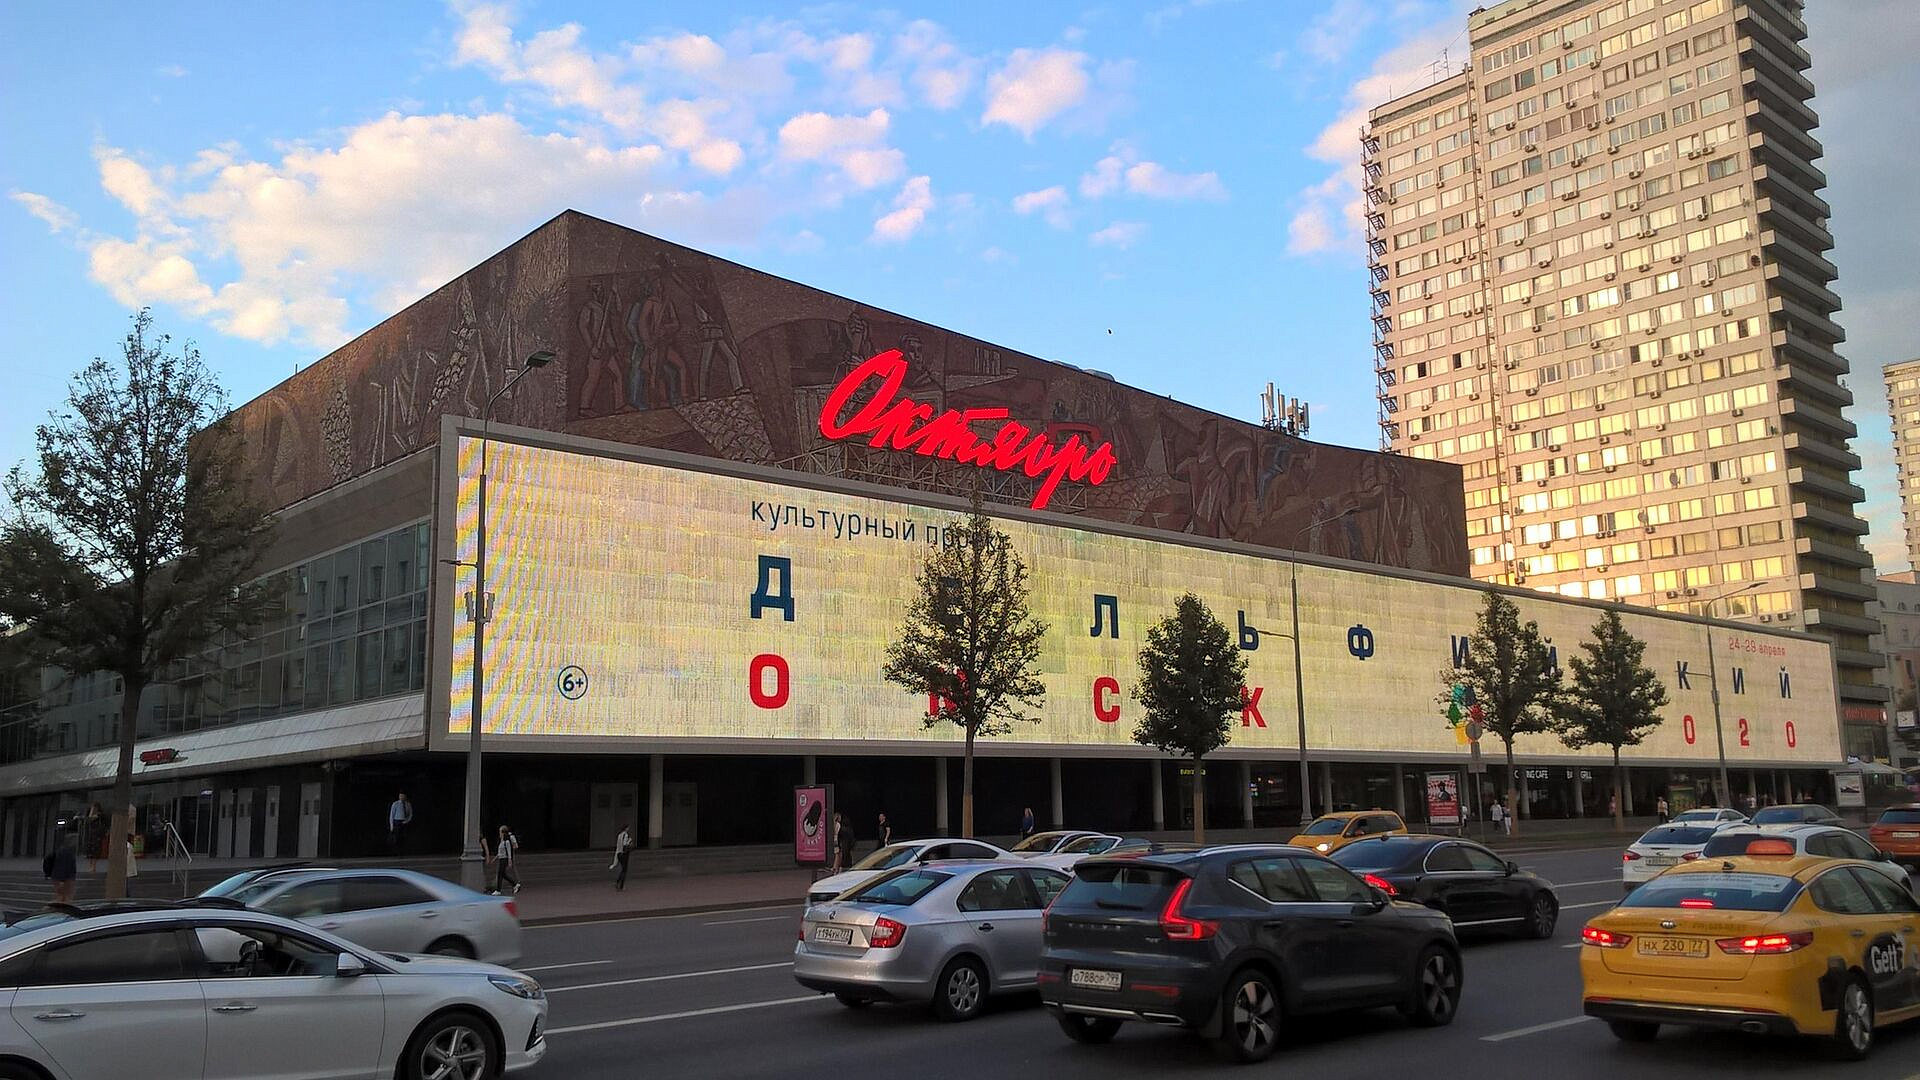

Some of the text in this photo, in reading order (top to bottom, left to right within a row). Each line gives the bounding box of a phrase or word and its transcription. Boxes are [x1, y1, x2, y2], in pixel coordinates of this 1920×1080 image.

[819, 349, 1117, 509] Октябрь
[751, 500, 915, 541] культурный
[563, 673, 584, 691] 6+
[1662, 939, 1685, 951] 230
[1692, 940, 1703, 951] 77
[1871, 943, 1898, 974] Gett
